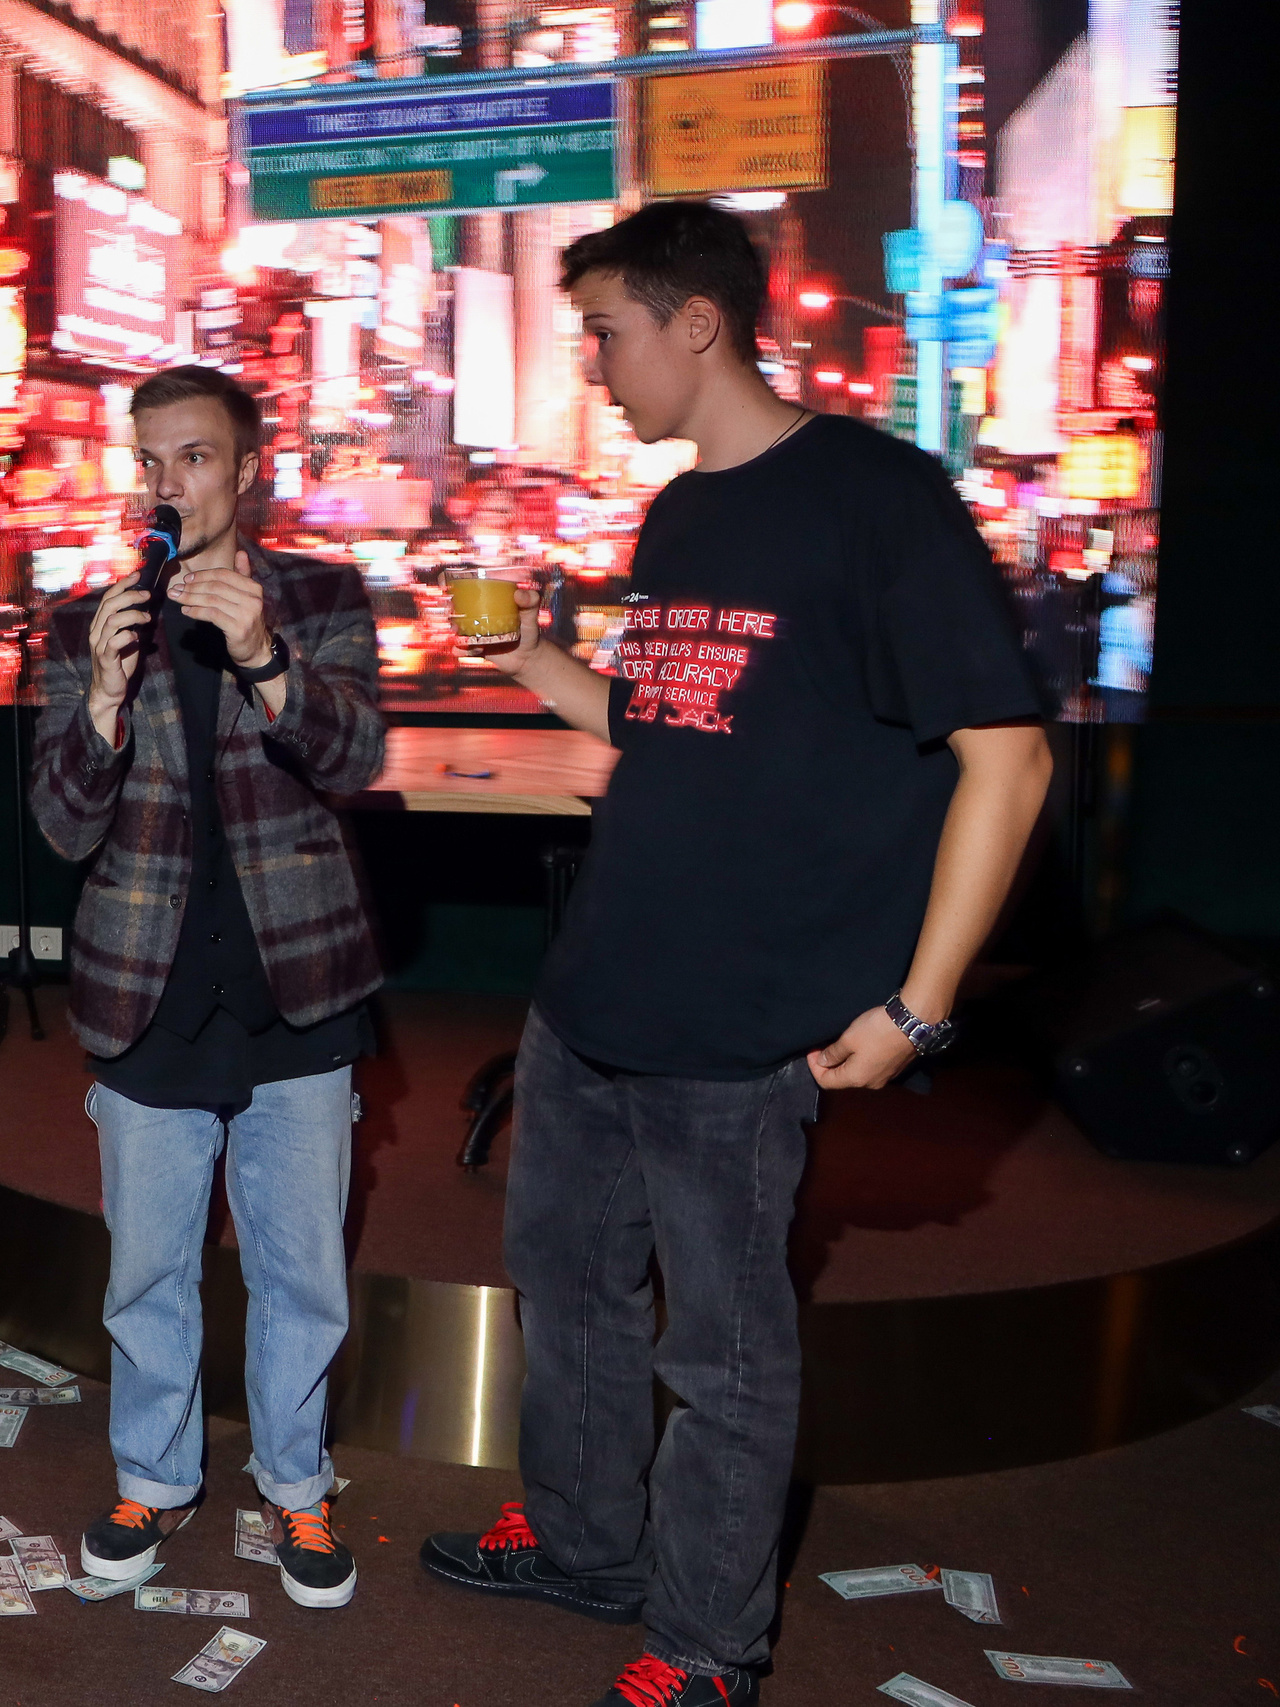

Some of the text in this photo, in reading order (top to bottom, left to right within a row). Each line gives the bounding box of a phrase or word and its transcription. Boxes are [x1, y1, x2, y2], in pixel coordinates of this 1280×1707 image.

[628, 592, 640, 602] 24
[718, 610, 775, 636] HERE
[615, 642, 641, 657] THIS
[697, 645, 748, 663] ENSURE
[657, 662, 738, 688] ACCURACY
[665, 686, 717, 706] SERVICE
[665, 705, 734, 735] JACK
[45, 1372, 67, 1383] 100
[900, 1567, 929, 1586] 100
[997, 1656, 1025, 1678] 100
